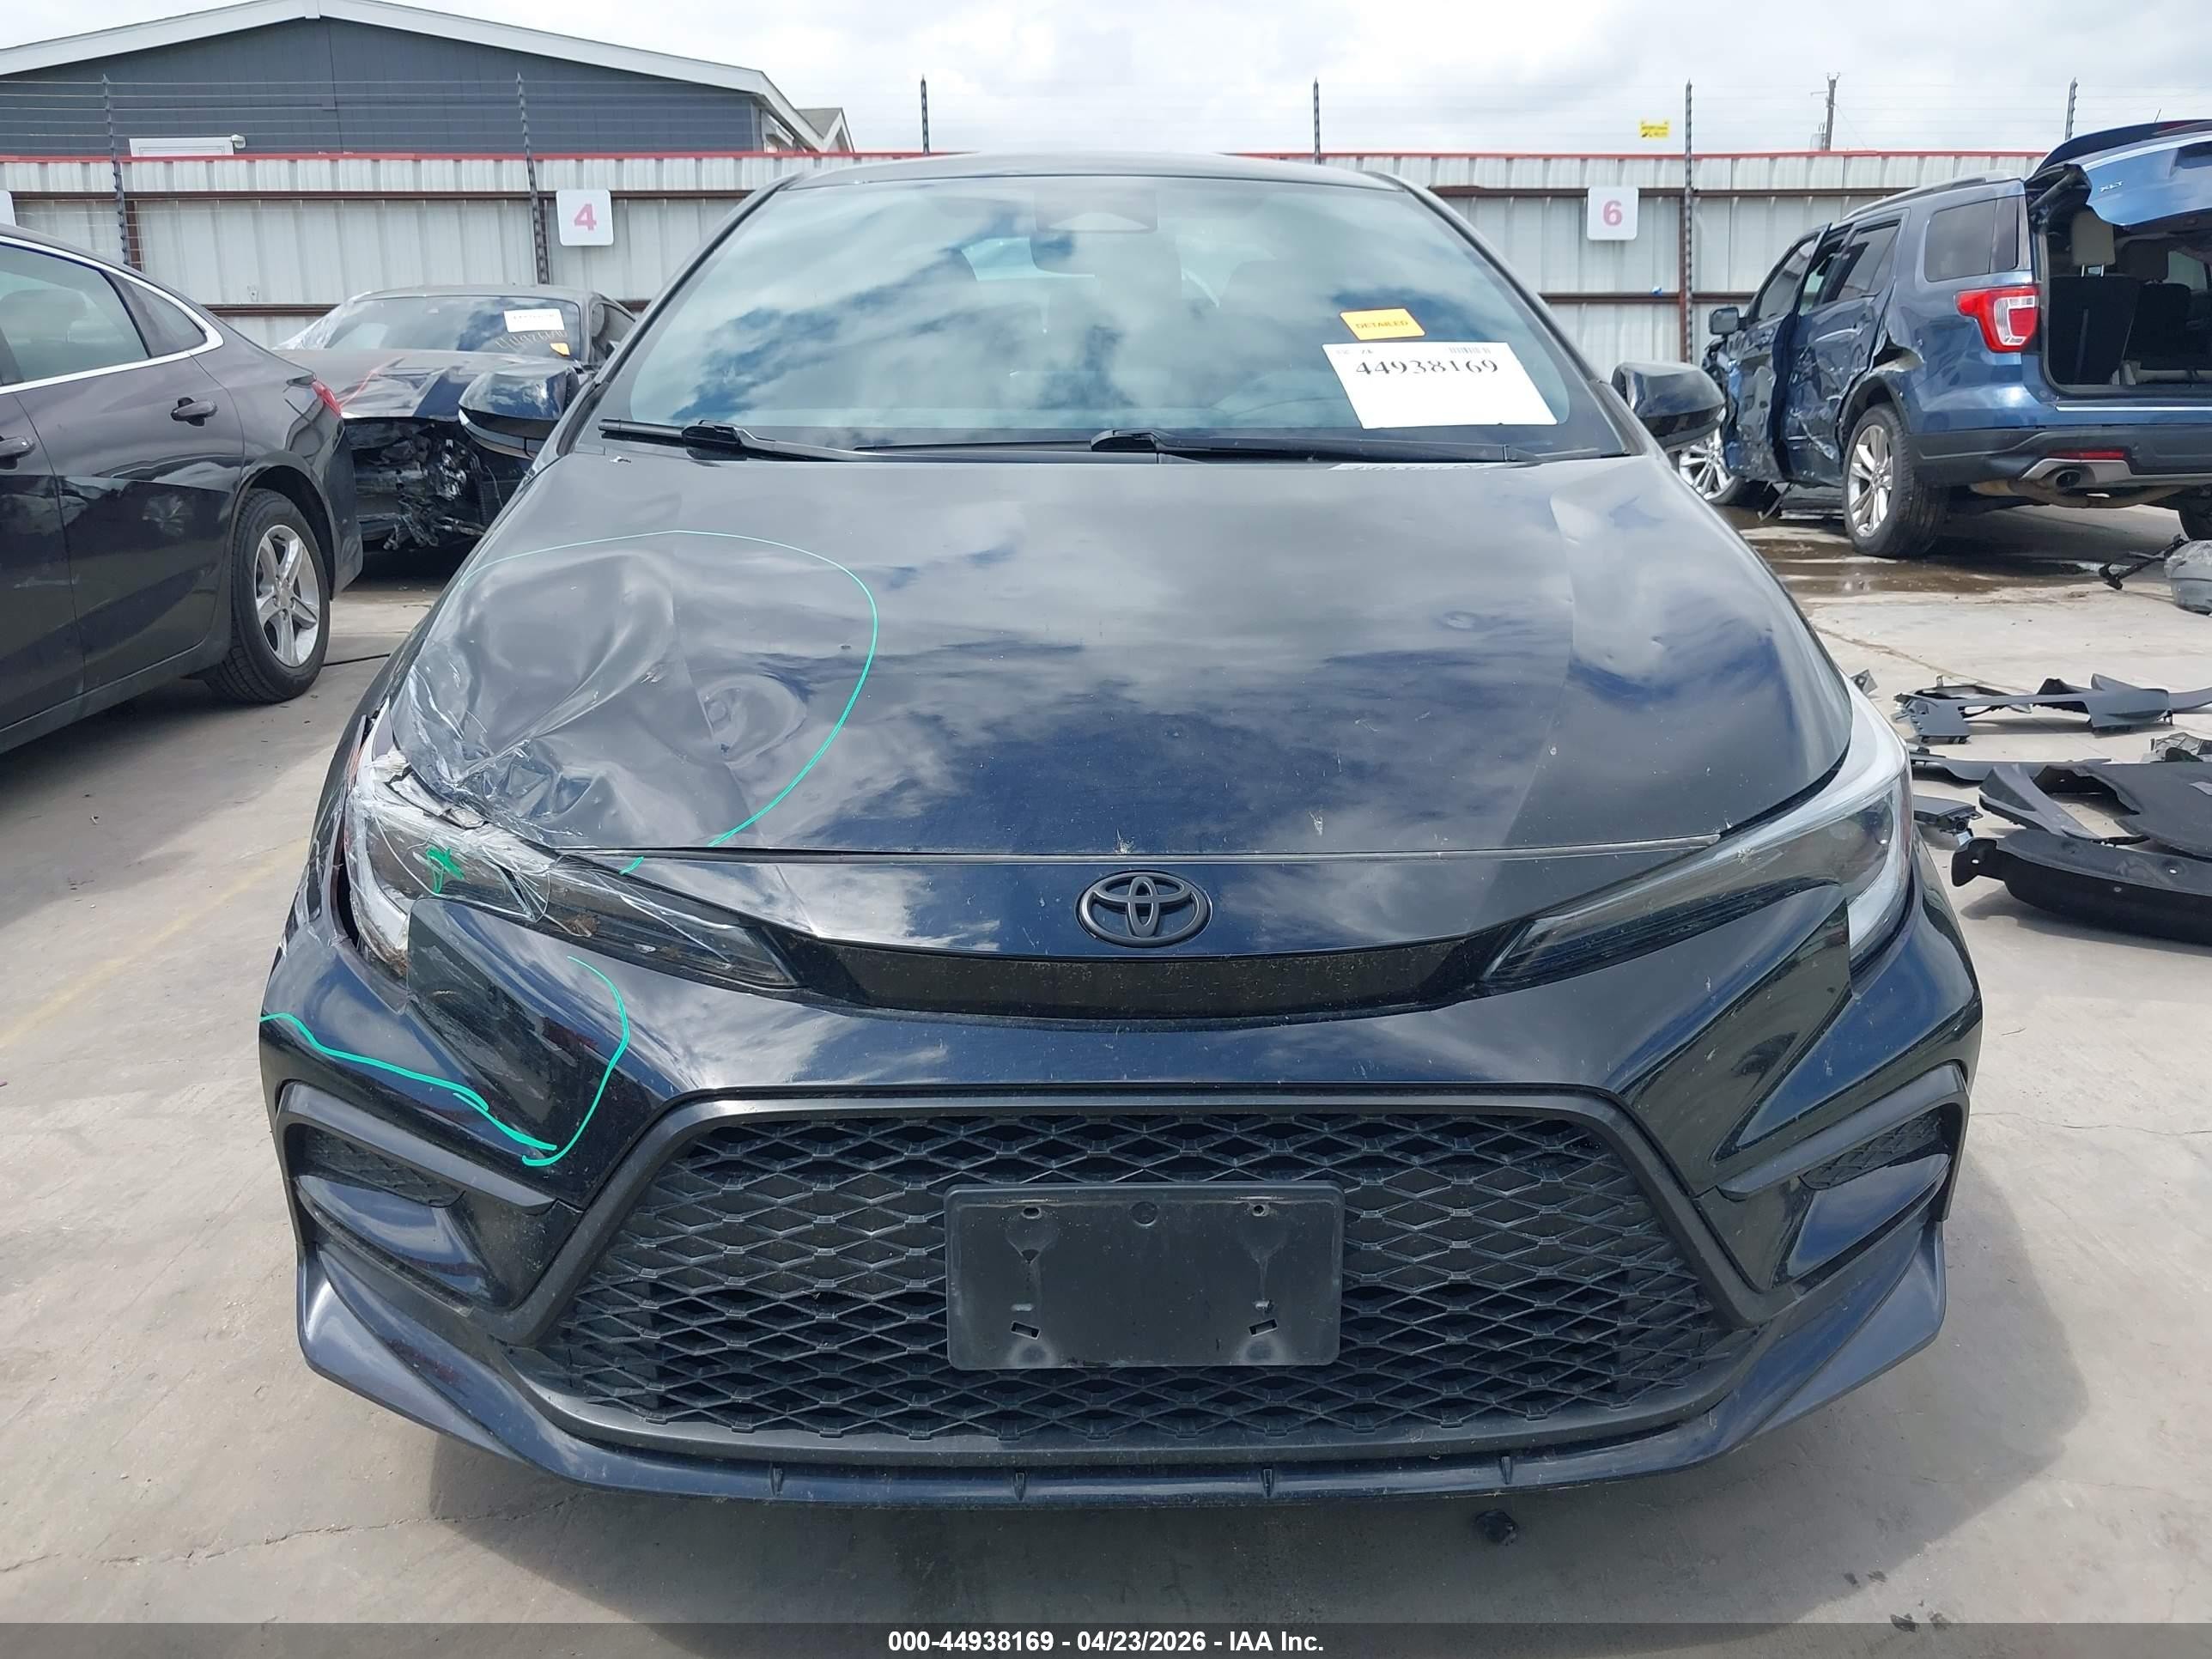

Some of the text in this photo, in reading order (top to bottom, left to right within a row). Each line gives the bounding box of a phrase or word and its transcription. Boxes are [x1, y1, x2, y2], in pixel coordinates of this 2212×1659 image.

[2099, 180, 2123, 193] XLT
[574, 203, 597, 231] 4
[1603, 200, 1622, 227] 6
[1355, 359, 1498, 375] 44938169
